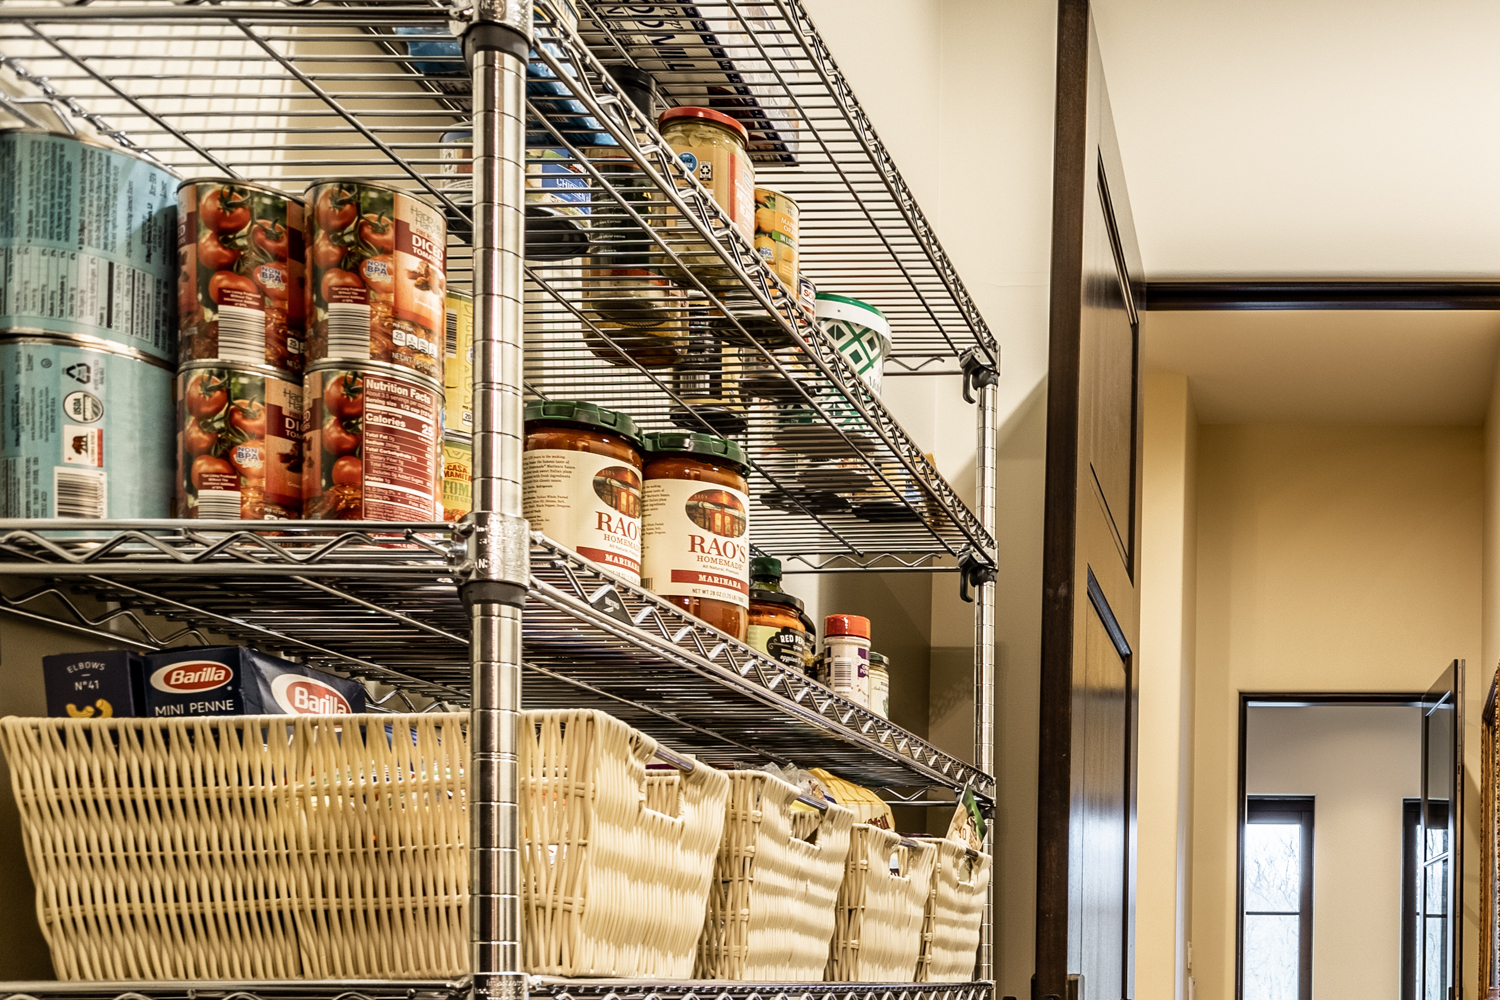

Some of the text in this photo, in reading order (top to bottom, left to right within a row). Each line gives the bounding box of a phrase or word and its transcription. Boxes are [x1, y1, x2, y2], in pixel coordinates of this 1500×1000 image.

[412, 234, 443, 261] DICED
[261, 265, 281, 275] NON
[367, 259, 387, 269] NON
[367, 266, 388, 276] BPA
[261, 272, 283, 283] BPA
[366, 378, 431, 405] Nutrition Facts
[73, 398, 82, 416] USDA
[365, 397, 386, 406] Serving
[366, 413, 434, 437] Calories 25
[237, 446, 257, 454] NON
[237, 452, 258, 461] BPA
[446, 464, 468, 473] CASA
[595, 511, 642, 540] RAO'
[688, 534, 746, 564] RAO'S
[696, 555, 744, 571] HOMEMADE
[698, 574, 742, 590] MARINARA
[780, 635, 794, 643] RED
[67, 661, 106, 675] ELBOWS
[169, 667, 226, 686] Barilla
[155, 699, 235, 717] MINI PENNE
[294, 687, 348, 715] Barilla
